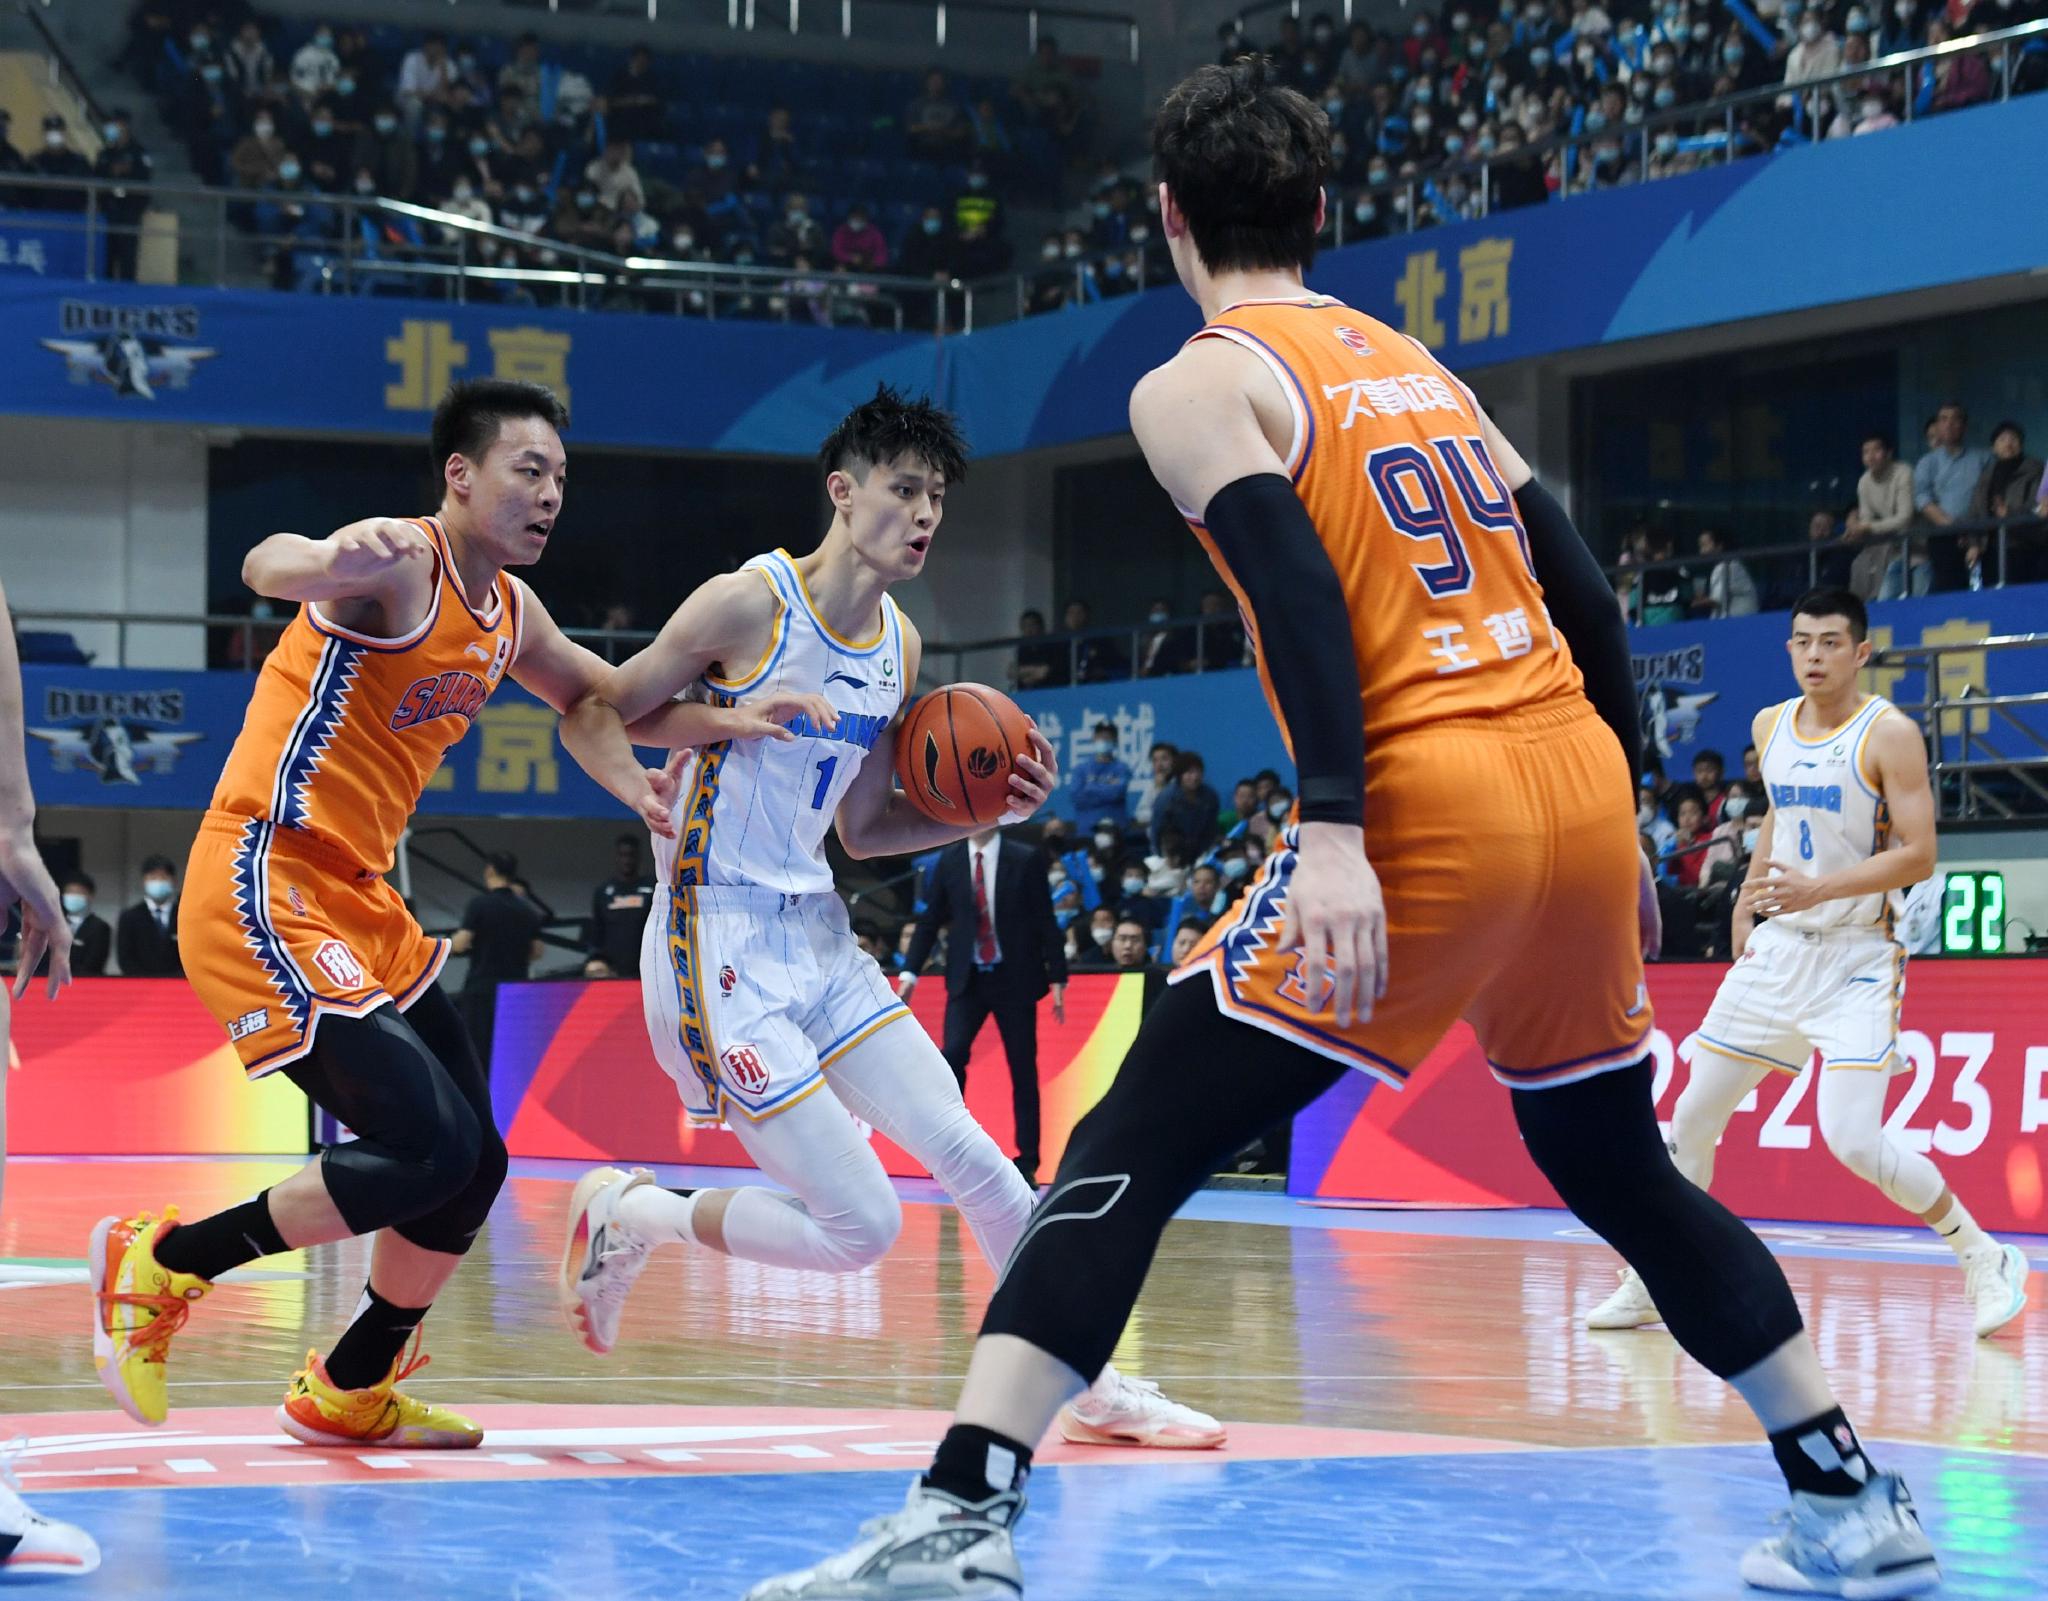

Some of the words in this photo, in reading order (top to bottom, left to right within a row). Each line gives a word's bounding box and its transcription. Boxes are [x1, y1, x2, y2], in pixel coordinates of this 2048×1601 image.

[61, 299, 199, 340] DUCKS
[1395, 236, 1513, 348] 北京
[1364, 436, 1538, 600] 94
[1422, 607, 1560, 675] 王哲
[1631, 643, 1704, 684] UCKS
[44, 684, 183, 724] DUCKS
[389, 671, 488, 733] SHAR
[811, 756, 838, 811] 1
[1769, 783, 1842, 815] BEIJING
[1799, 819, 1814, 861] 8
[1945, 875, 2003, 951] 22
